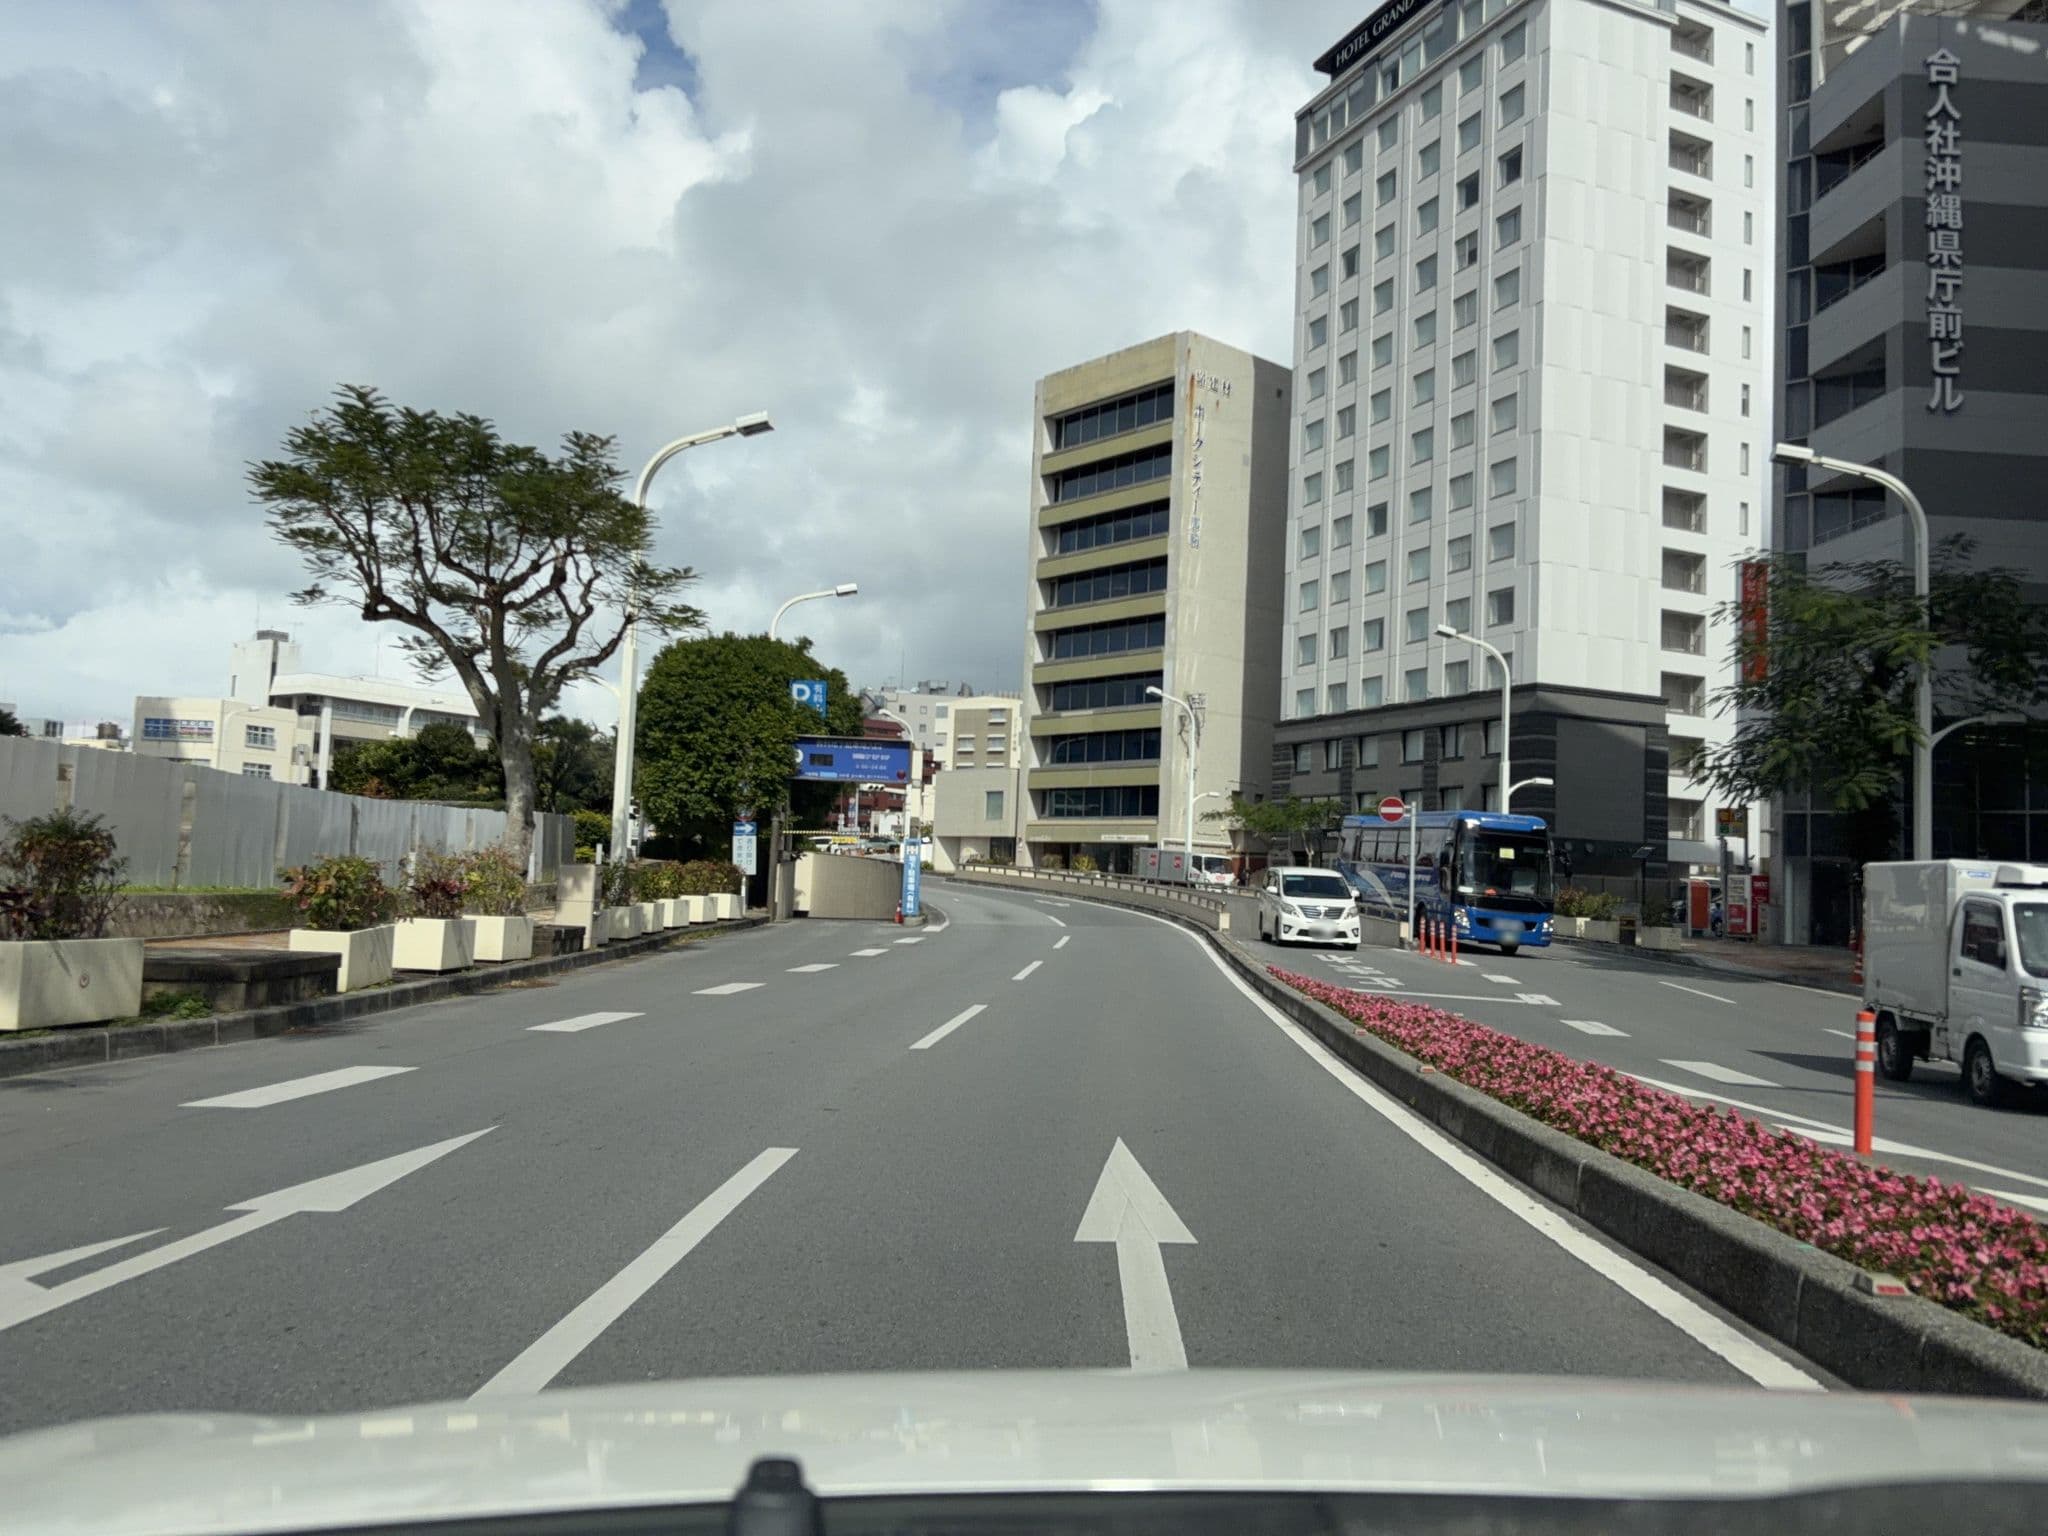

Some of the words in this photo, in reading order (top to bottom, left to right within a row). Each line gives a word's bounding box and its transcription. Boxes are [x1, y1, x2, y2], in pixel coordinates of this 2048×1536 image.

[1336, 32, 1370, 67] HOTEL
[1372, 0, 1415, 37] GRAND
[1926, 48, 1964, 411] 合人社沖縄県庁前ビル
